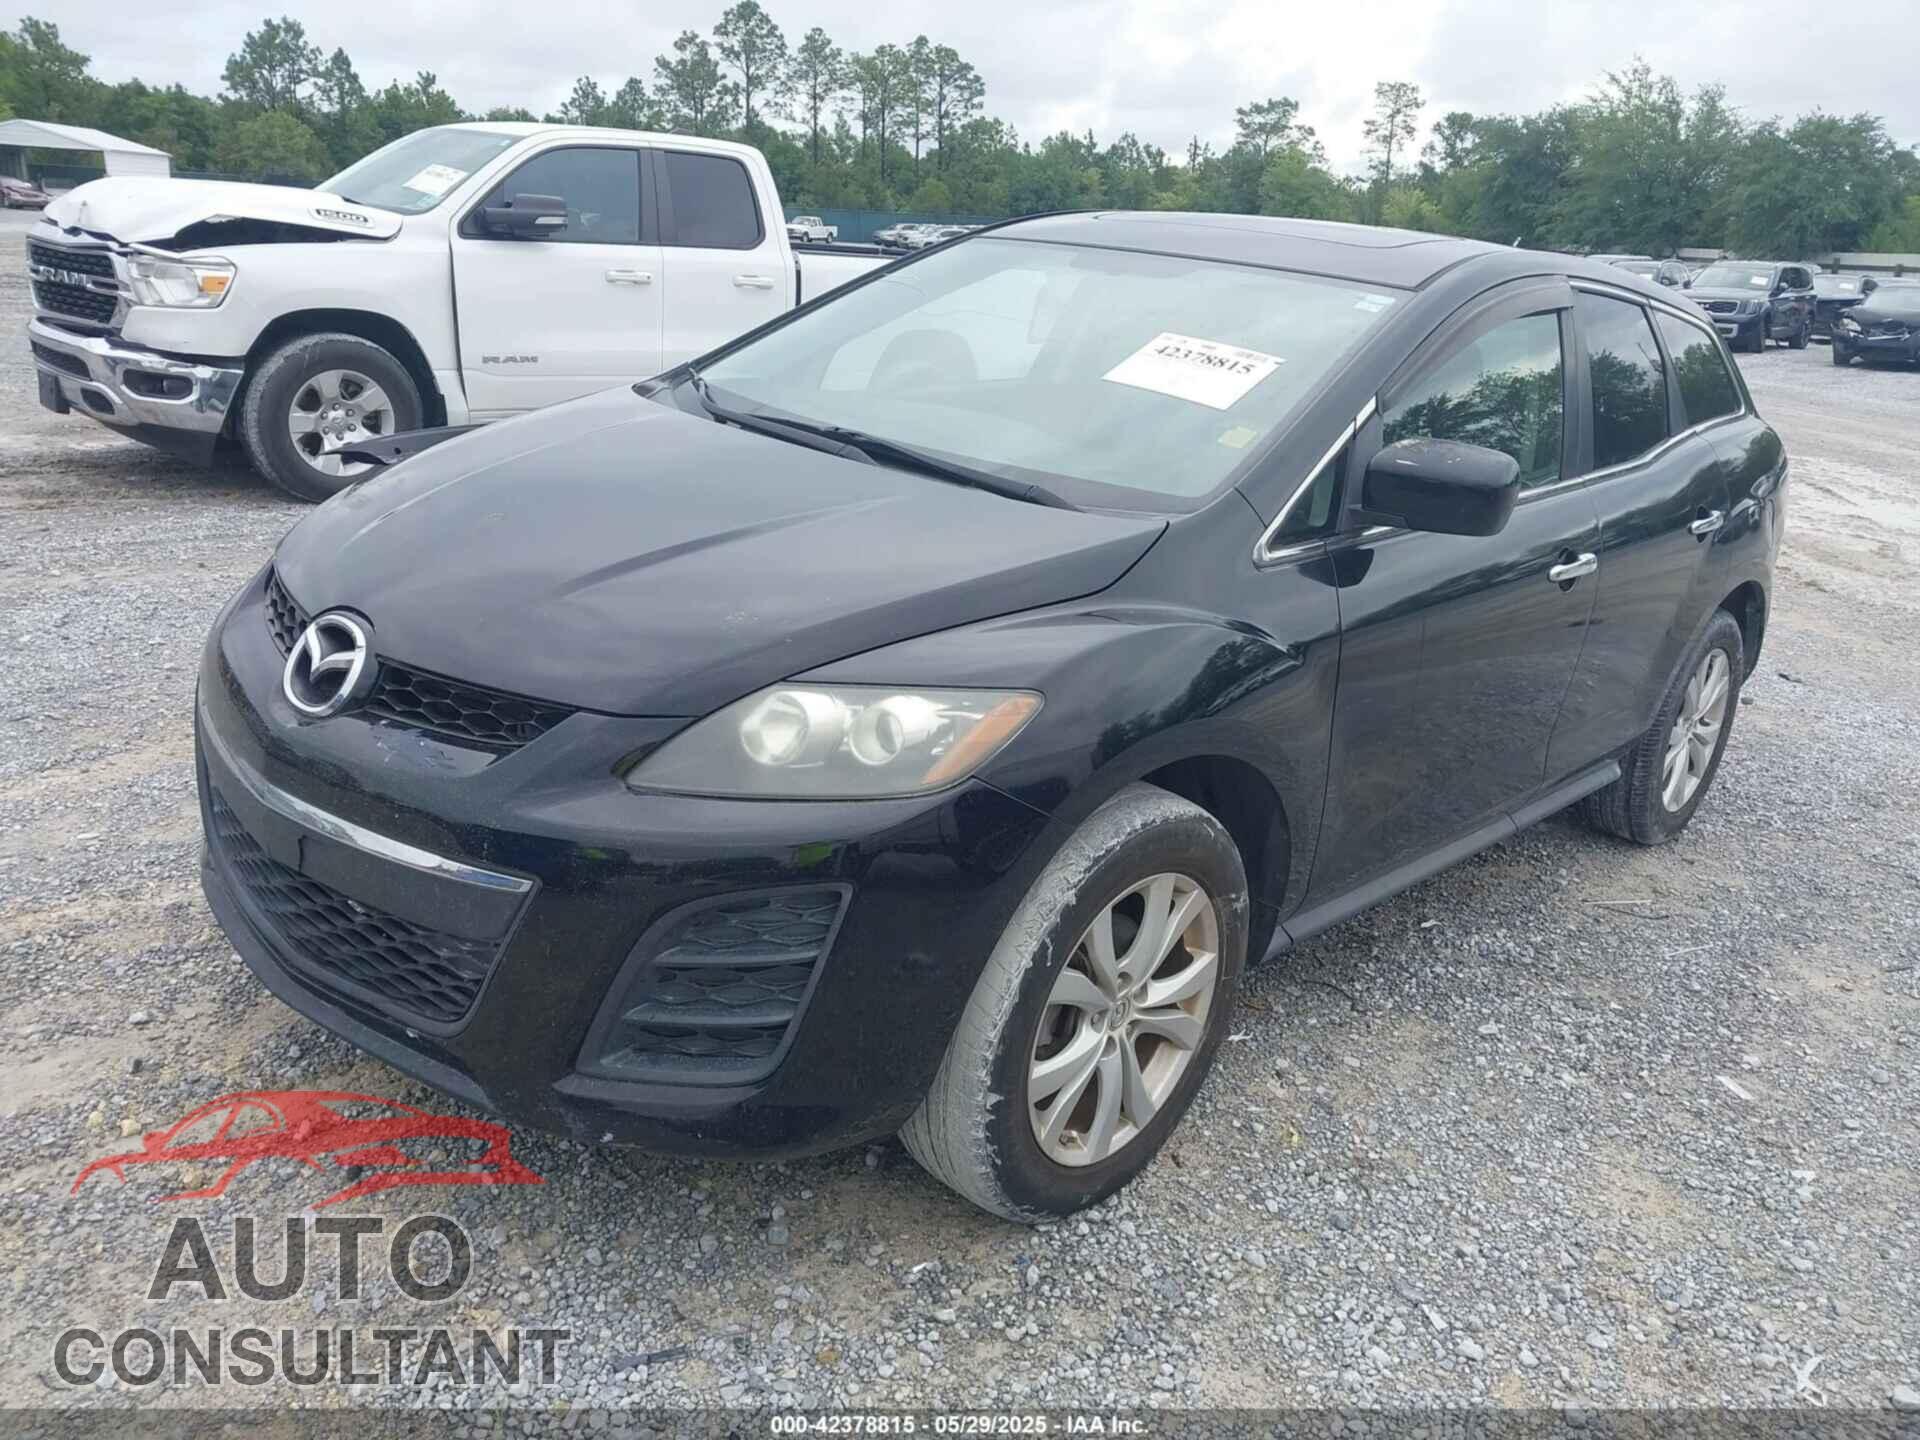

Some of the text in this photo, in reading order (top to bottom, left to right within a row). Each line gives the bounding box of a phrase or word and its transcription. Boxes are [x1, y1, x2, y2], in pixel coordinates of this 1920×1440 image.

[40, 265, 88, 287] RAM
[481, 355, 539, 365] RAM
[1154, 345, 1257, 375] 42378815
